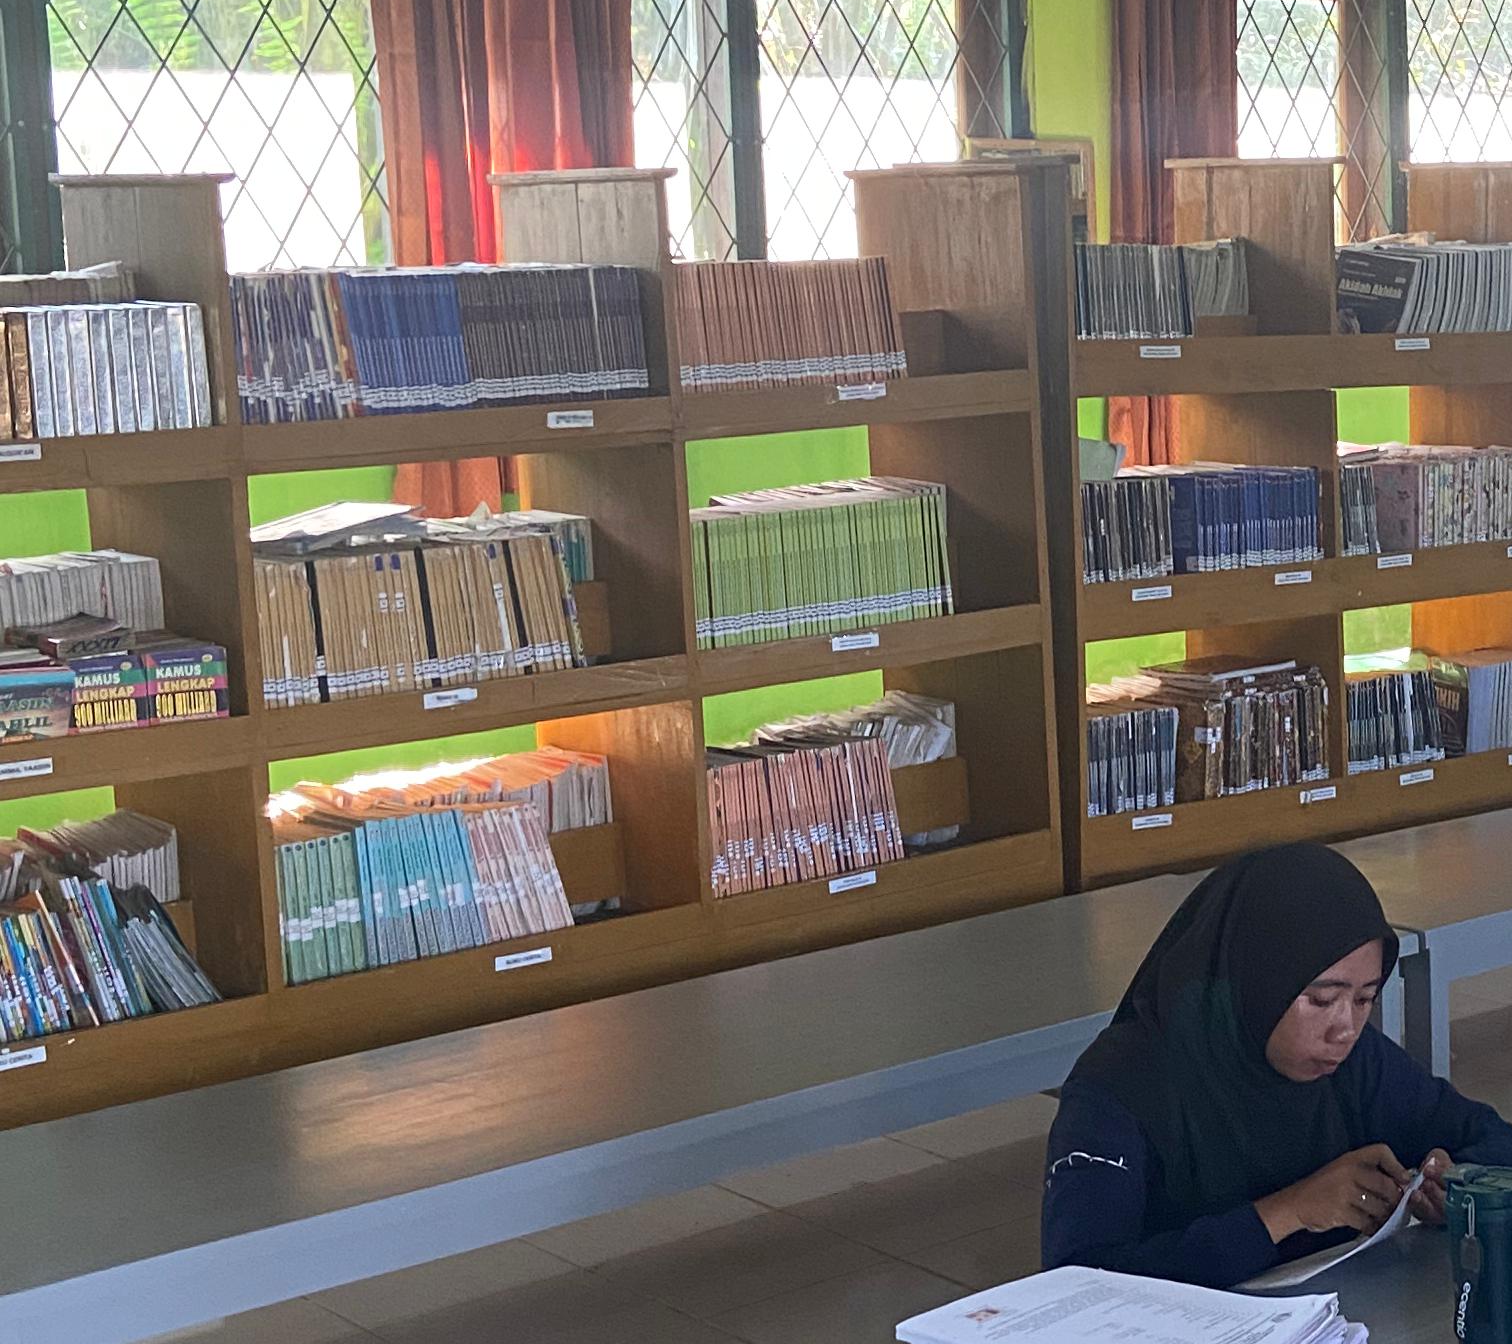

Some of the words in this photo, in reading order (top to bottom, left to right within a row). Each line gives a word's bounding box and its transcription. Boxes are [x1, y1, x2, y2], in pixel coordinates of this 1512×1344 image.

[155, 663, 202, 679] KAMUS
[74, 672, 121, 689] KAMUS
[156, 677, 216, 694] LENGKAP
[75, 685, 136, 704] LENGKAP
[155, 693, 174, 718] 900
[74, 704, 94, 729] 900
